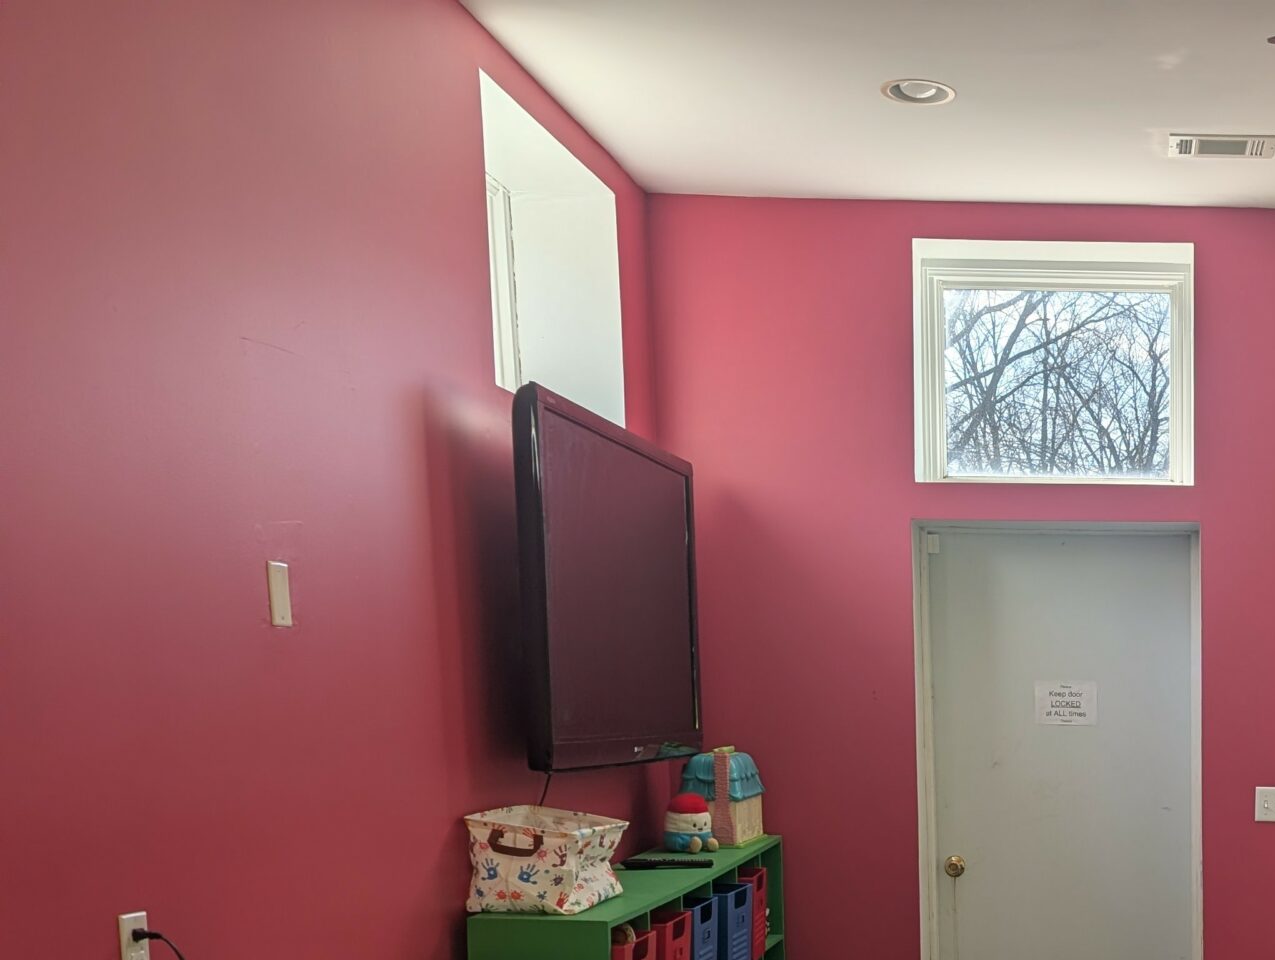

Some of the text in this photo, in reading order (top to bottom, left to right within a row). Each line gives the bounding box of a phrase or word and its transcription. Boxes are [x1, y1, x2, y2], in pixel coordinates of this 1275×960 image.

[1048, 690, 1066, 698] Keep
[1050, 699, 1081, 708] LOCKED
[1068, 710, 1087, 718] times
